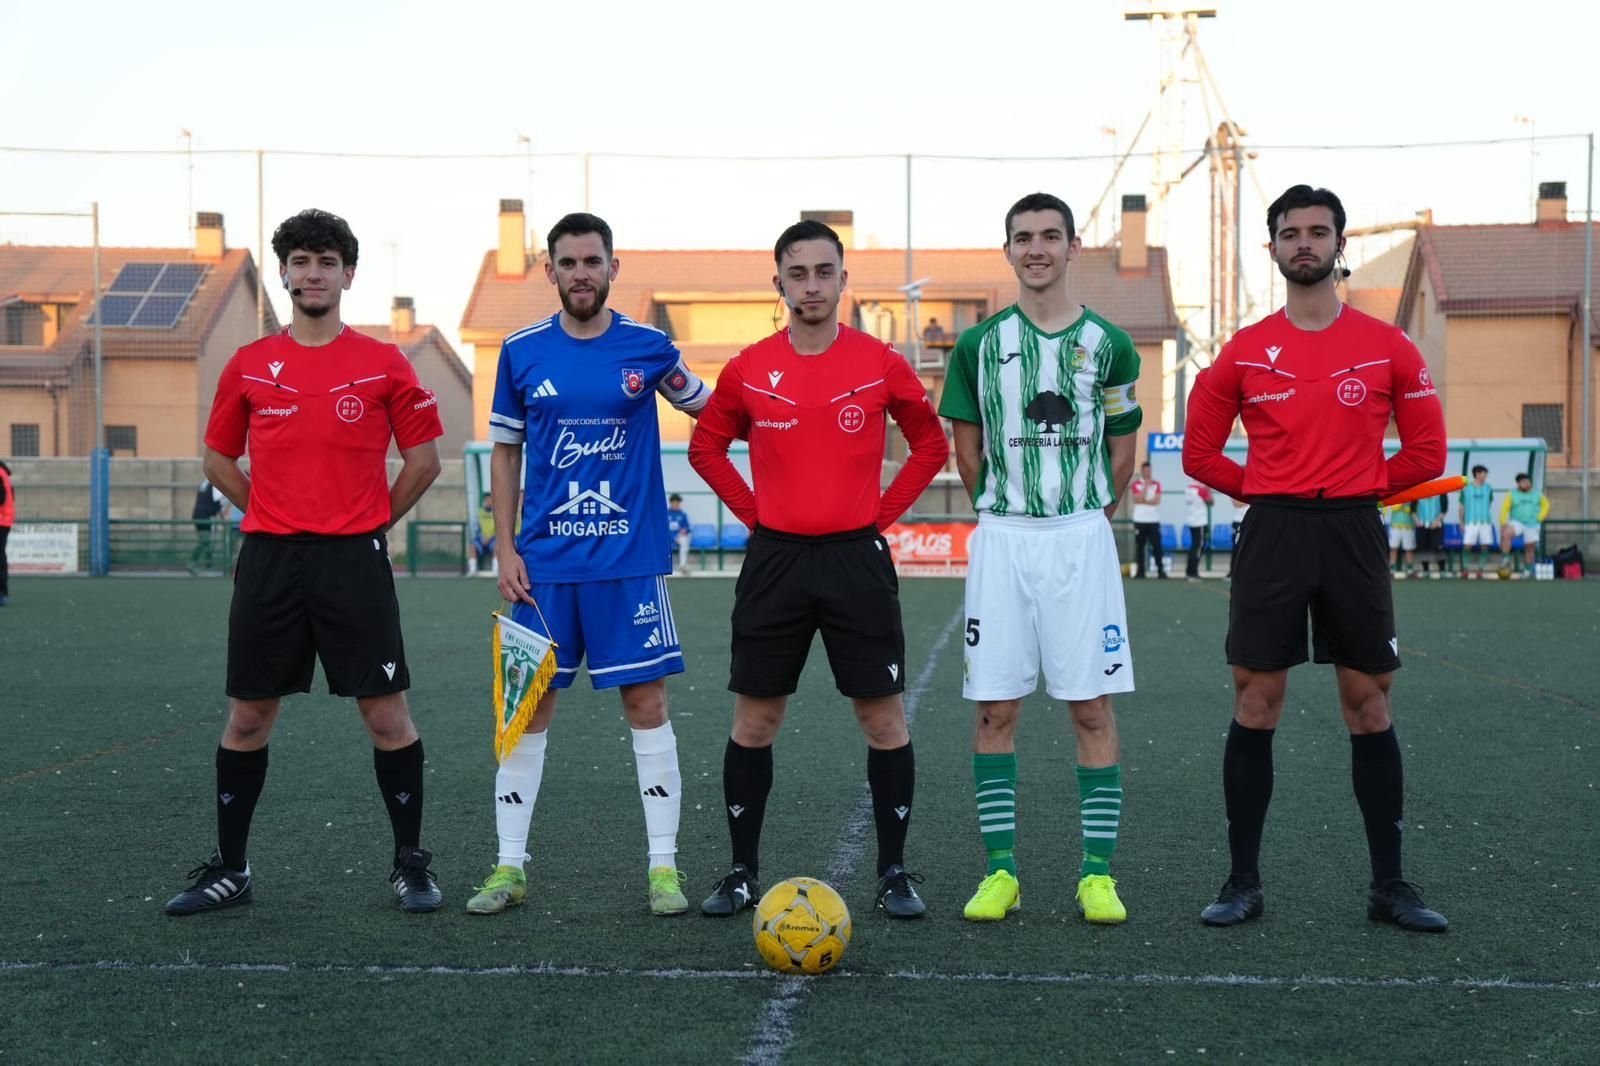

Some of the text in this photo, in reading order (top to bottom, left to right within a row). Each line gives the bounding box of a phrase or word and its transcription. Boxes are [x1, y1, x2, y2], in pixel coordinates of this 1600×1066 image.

[550, 426, 626, 469] Budi
[601, 452, 625, 461] MUSIC
[549, 519, 629, 537] HOGARES
[965, 617, 980, 647] 5
